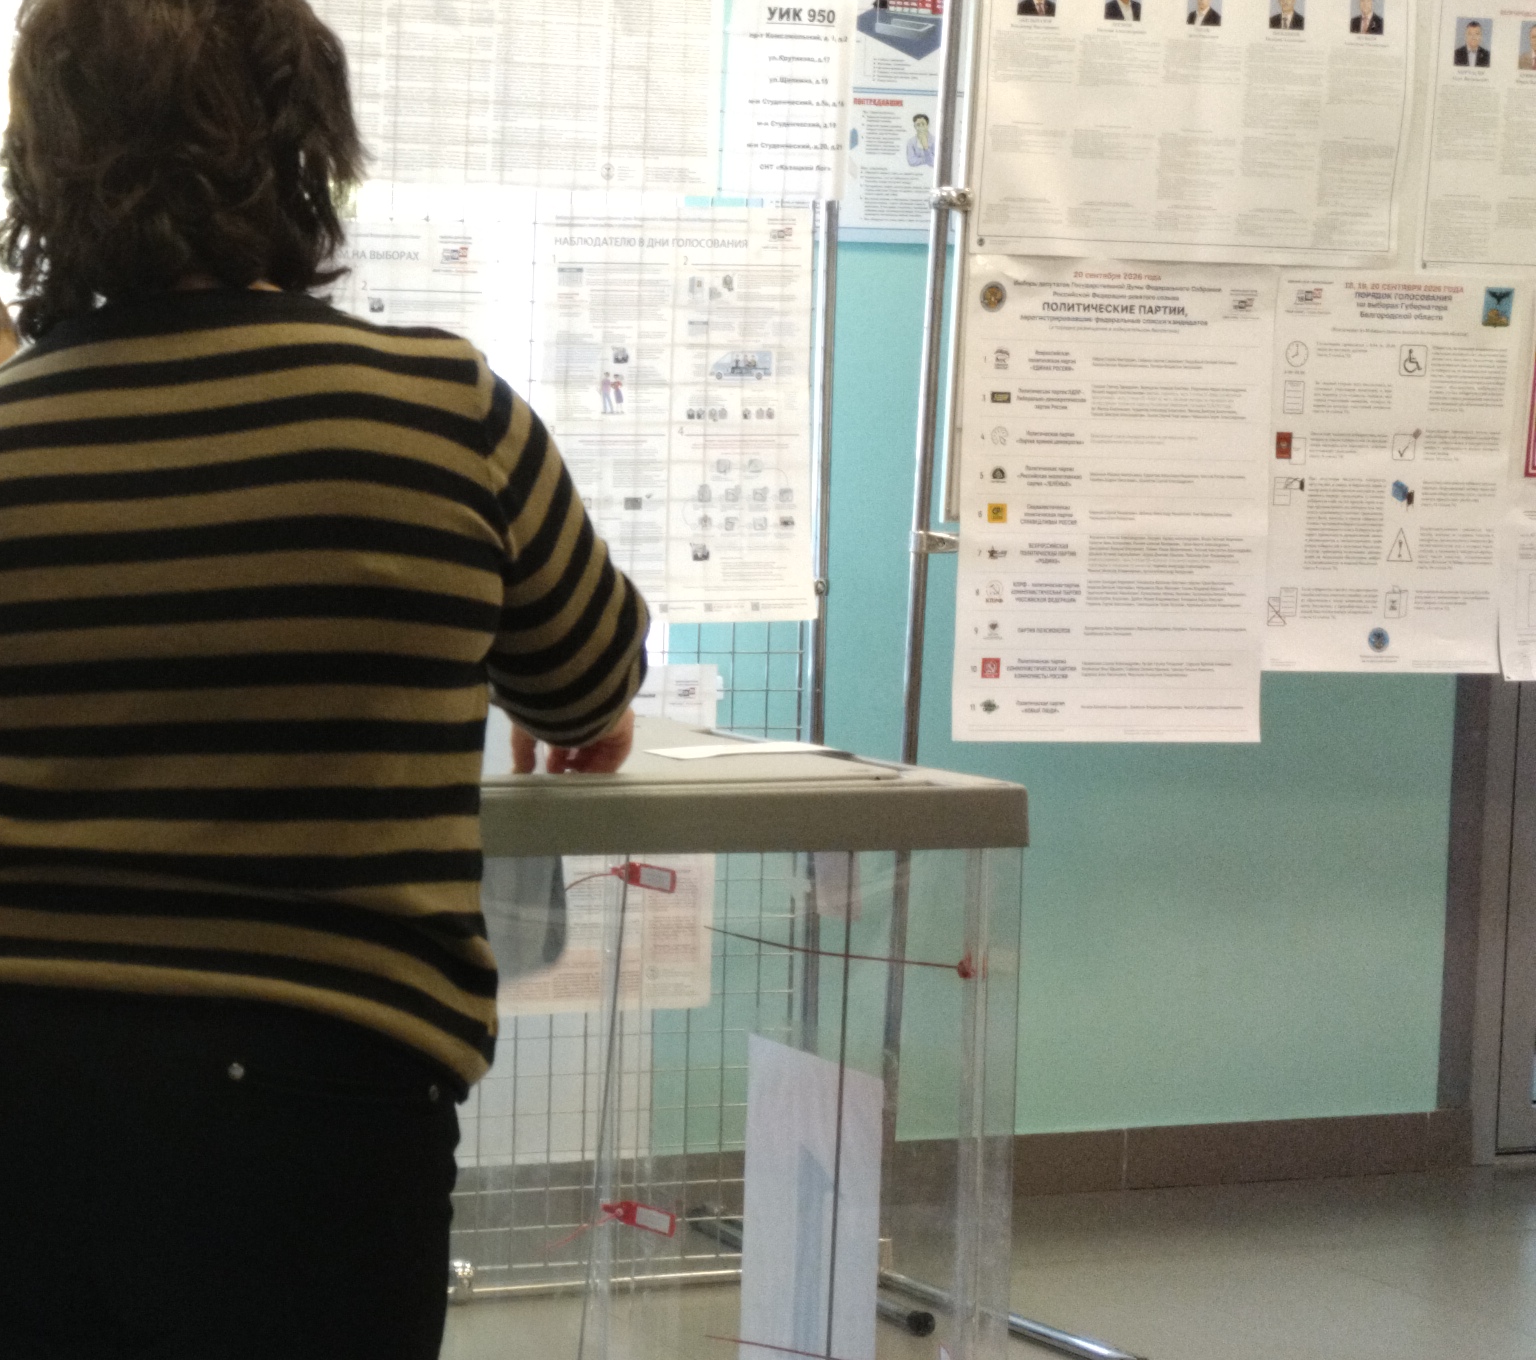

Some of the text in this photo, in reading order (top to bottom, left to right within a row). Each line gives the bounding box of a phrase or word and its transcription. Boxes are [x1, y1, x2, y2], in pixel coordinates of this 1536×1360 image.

[767, 6, 836, 24] УИК 950
[554, 236, 636, 248] НАБЛЮДАТЕЛЮ
[646, 237, 669, 248] ДНИ
[671, 238, 748, 249] ГОЛОСОВАНИЯ
[352, 250, 367, 260] НА
[369, 250, 420, 261] ВЫБОРАХ
[1073, 271, 1083, 279] 20
[1085, 272, 1121, 281] сентября
[1394, 293, 1453, 301] ГОЛОСОВАНИЯ
[1042, 301, 1188, 318] ПОЛИТИЧЕСКИЕ ПАРТИИ,
